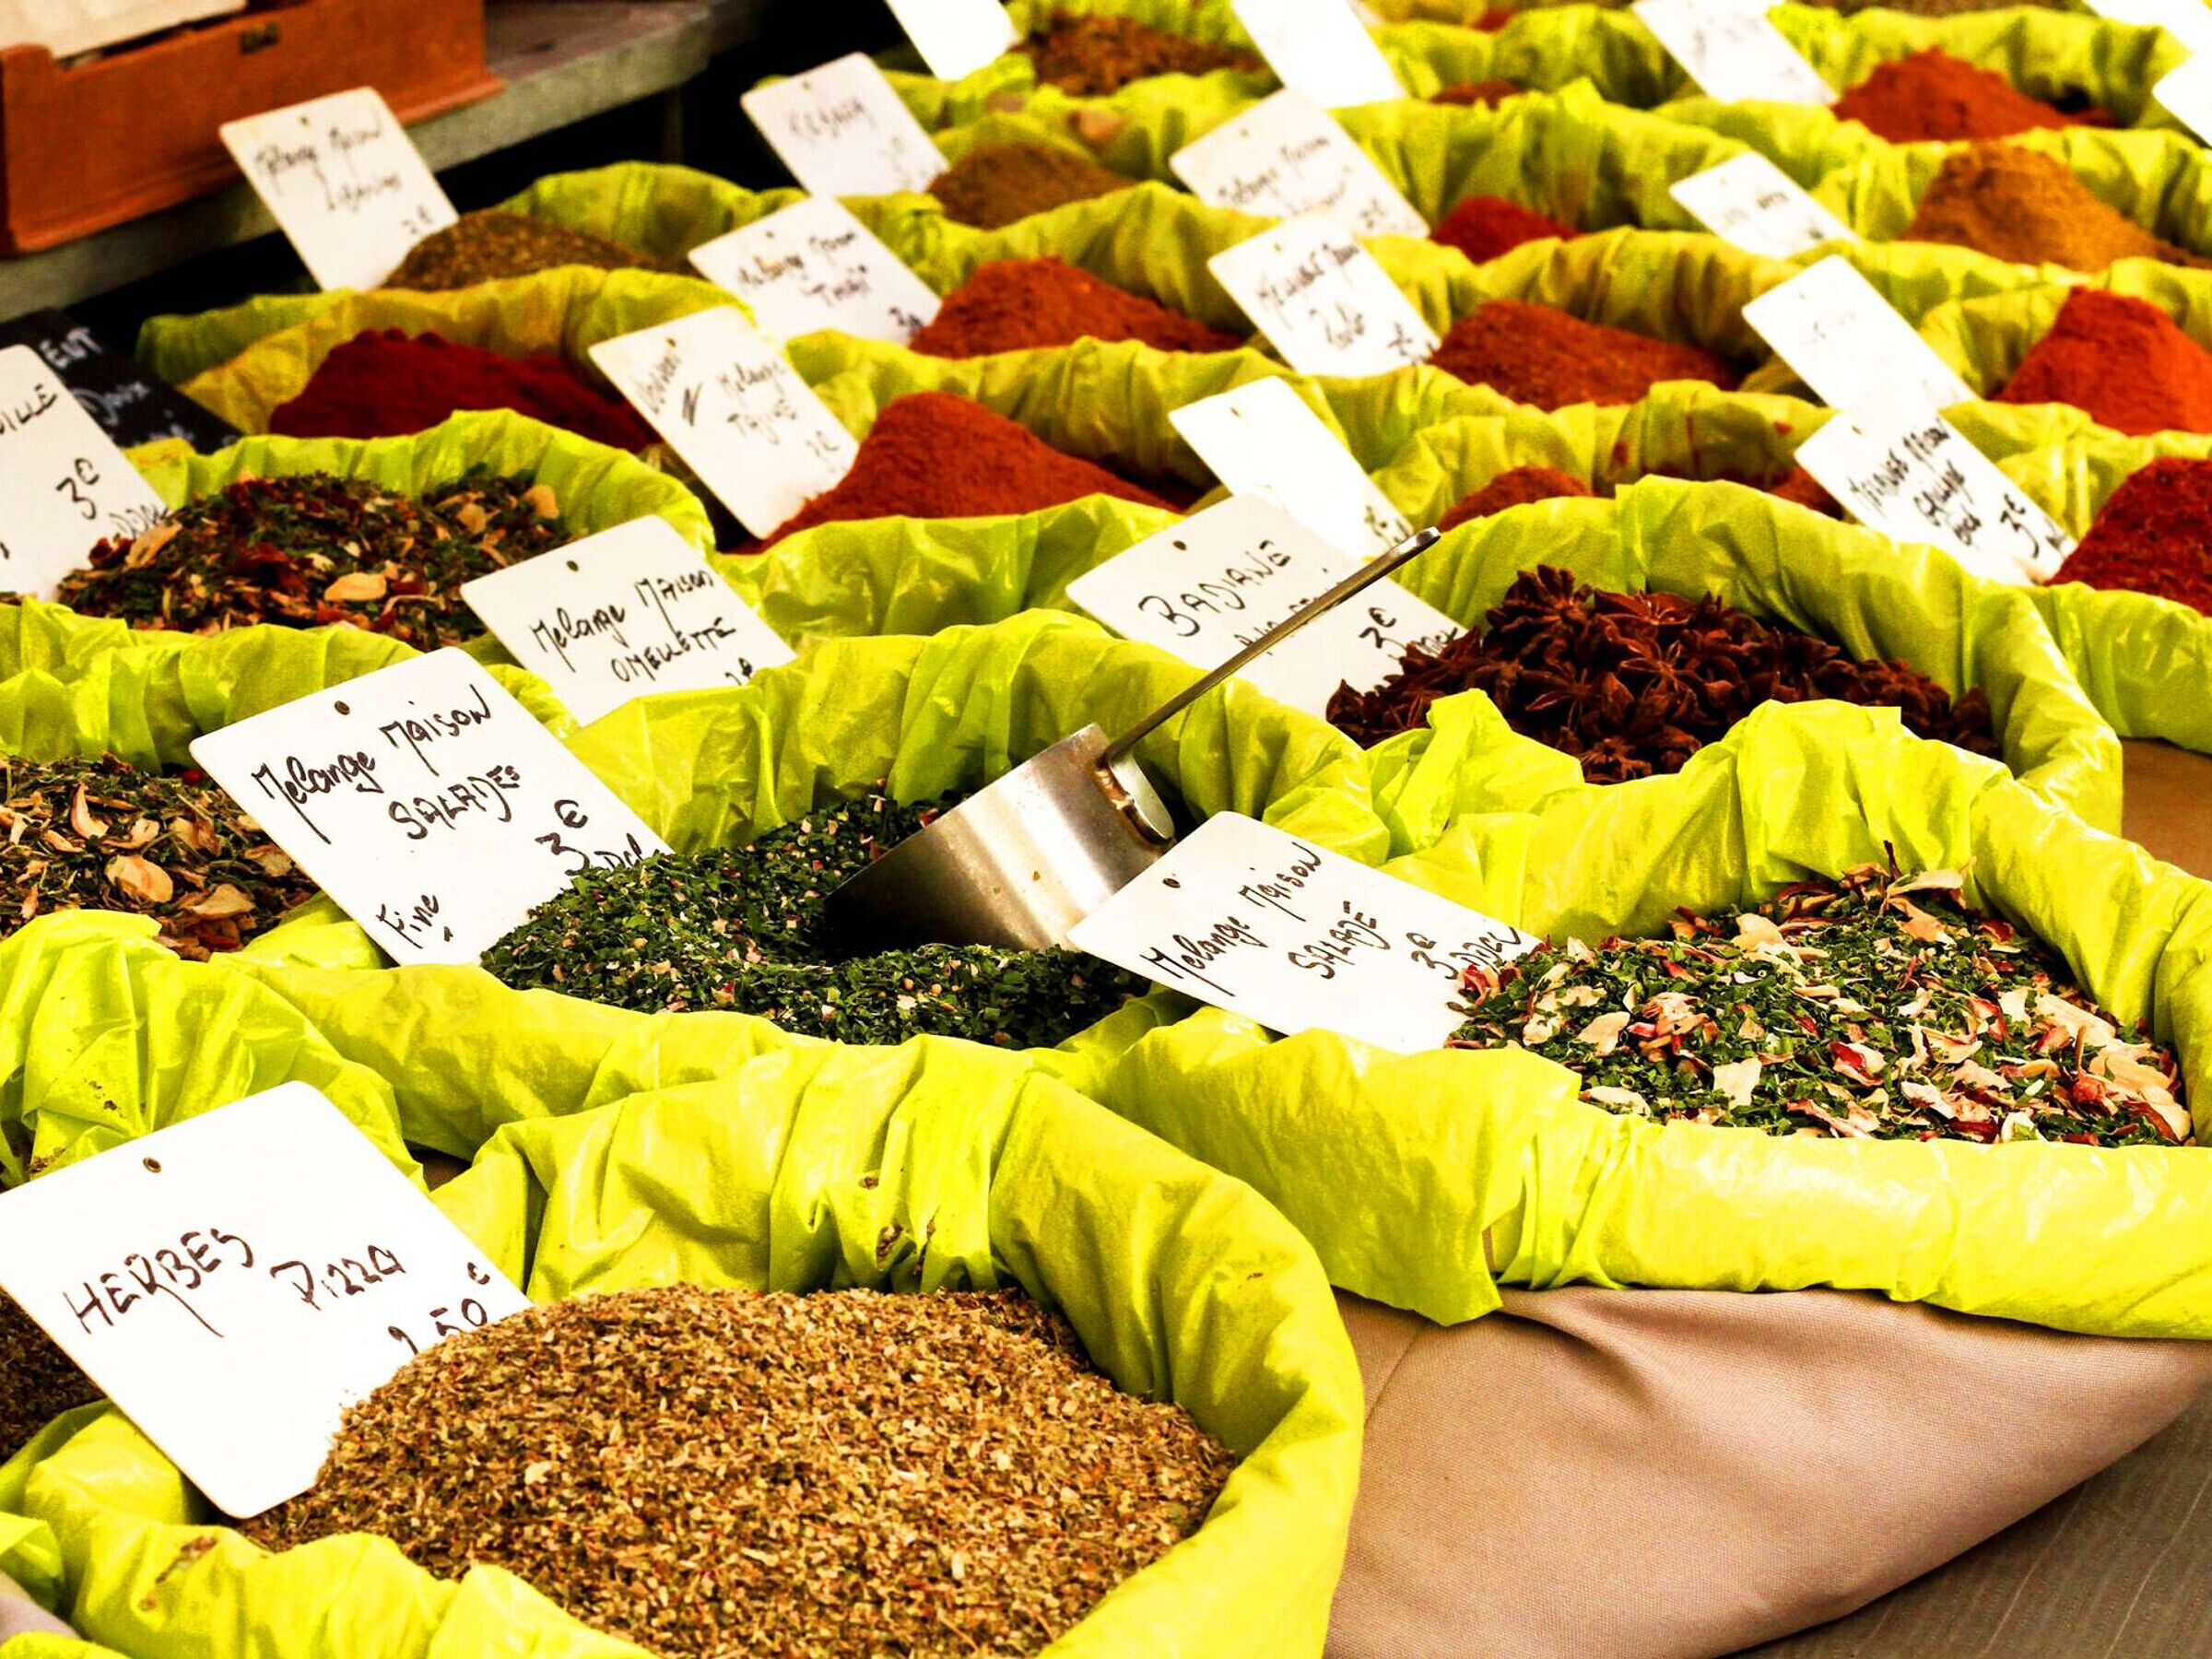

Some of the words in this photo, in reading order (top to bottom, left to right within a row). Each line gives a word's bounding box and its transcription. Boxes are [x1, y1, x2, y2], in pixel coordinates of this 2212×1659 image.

[250, 750, 384, 845] Melange
[1139, 915, 1269, 997] Melange
[62, 1228, 254, 1338] HERBES
